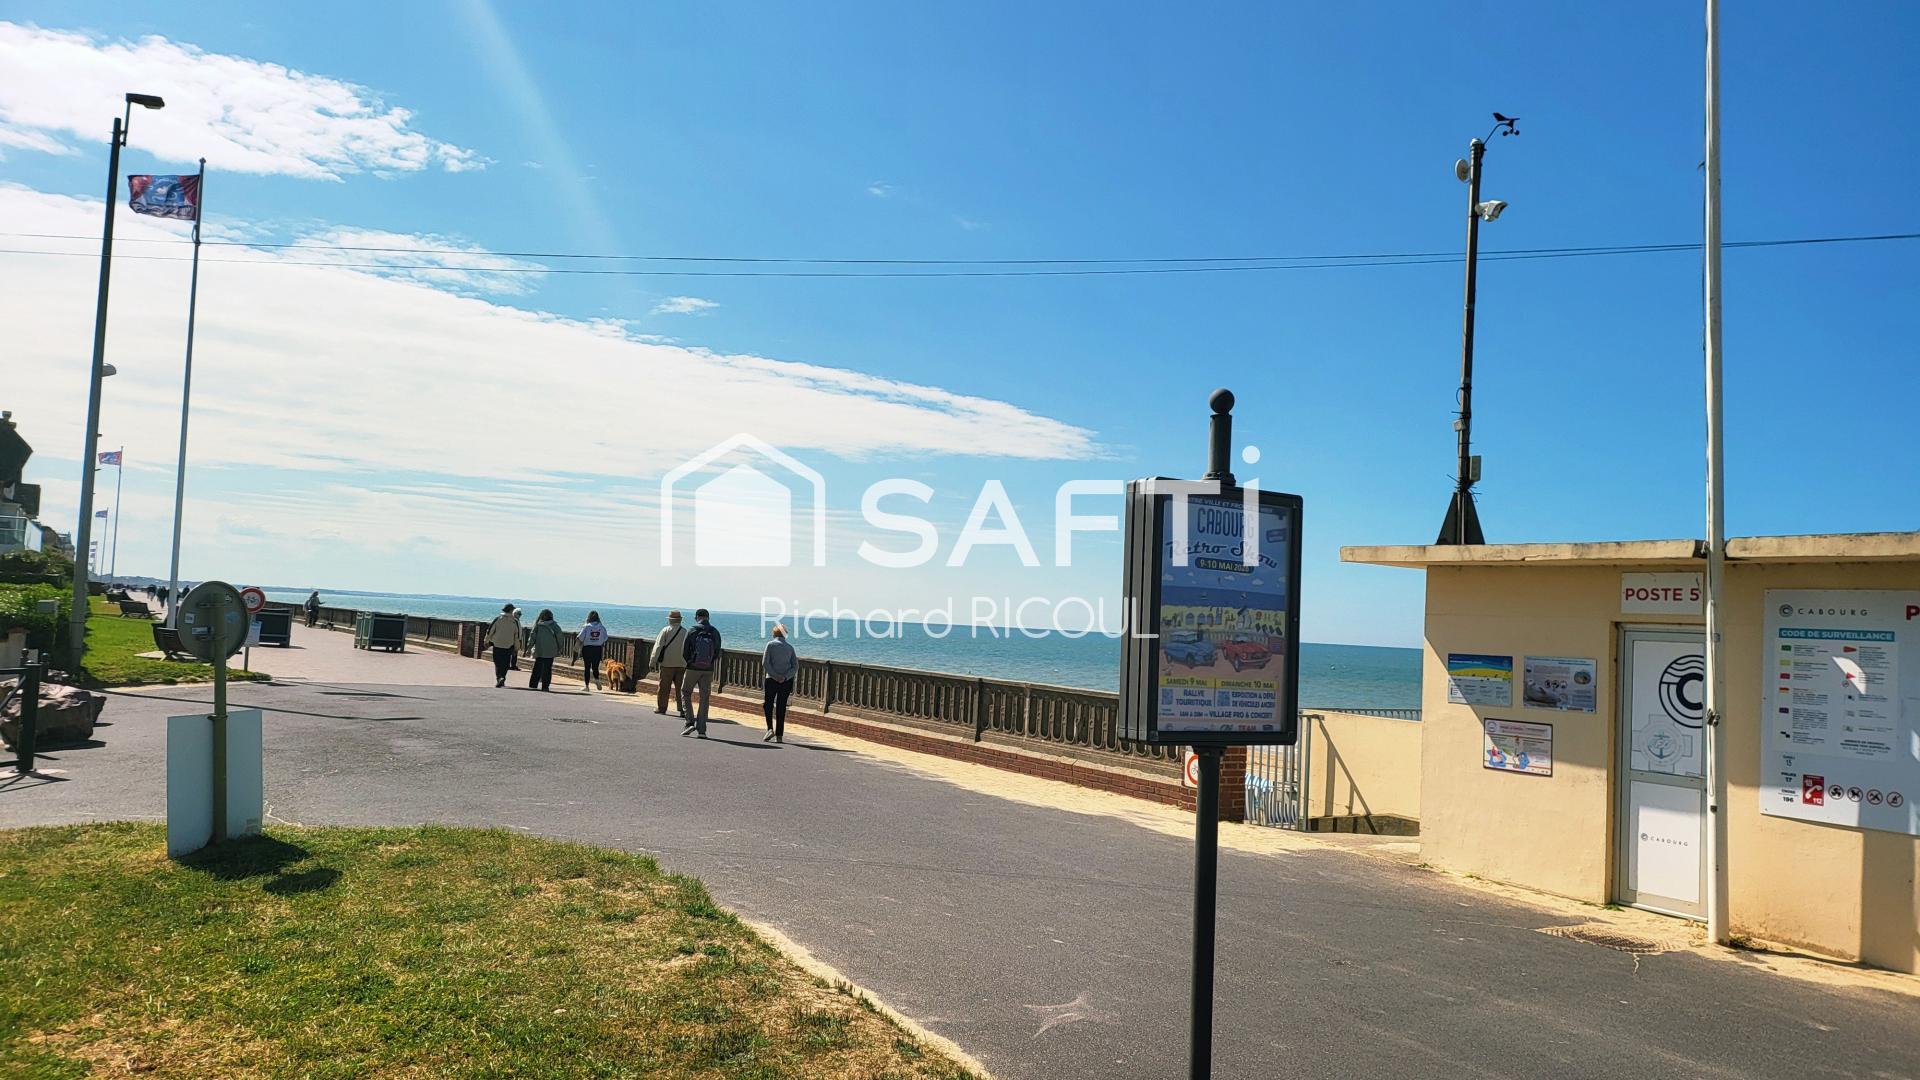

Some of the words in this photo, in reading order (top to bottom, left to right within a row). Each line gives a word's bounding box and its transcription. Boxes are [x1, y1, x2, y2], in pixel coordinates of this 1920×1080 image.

[1200, 559, 1217, 568] 9-10
[1218, 561, 1233, 570] MAI
[1625, 587, 1683, 601] POSTE
[1689, 587, 1700, 601] 5
[1798, 608, 1868, 617] CABOURG
[1807, 630, 1819, 638] DE
[1822, 631, 1893, 640] SURVEILLANCE
[1183, 689, 1205, 697] RALLYE
[1650, 836, 1688, 847] CABOURG
